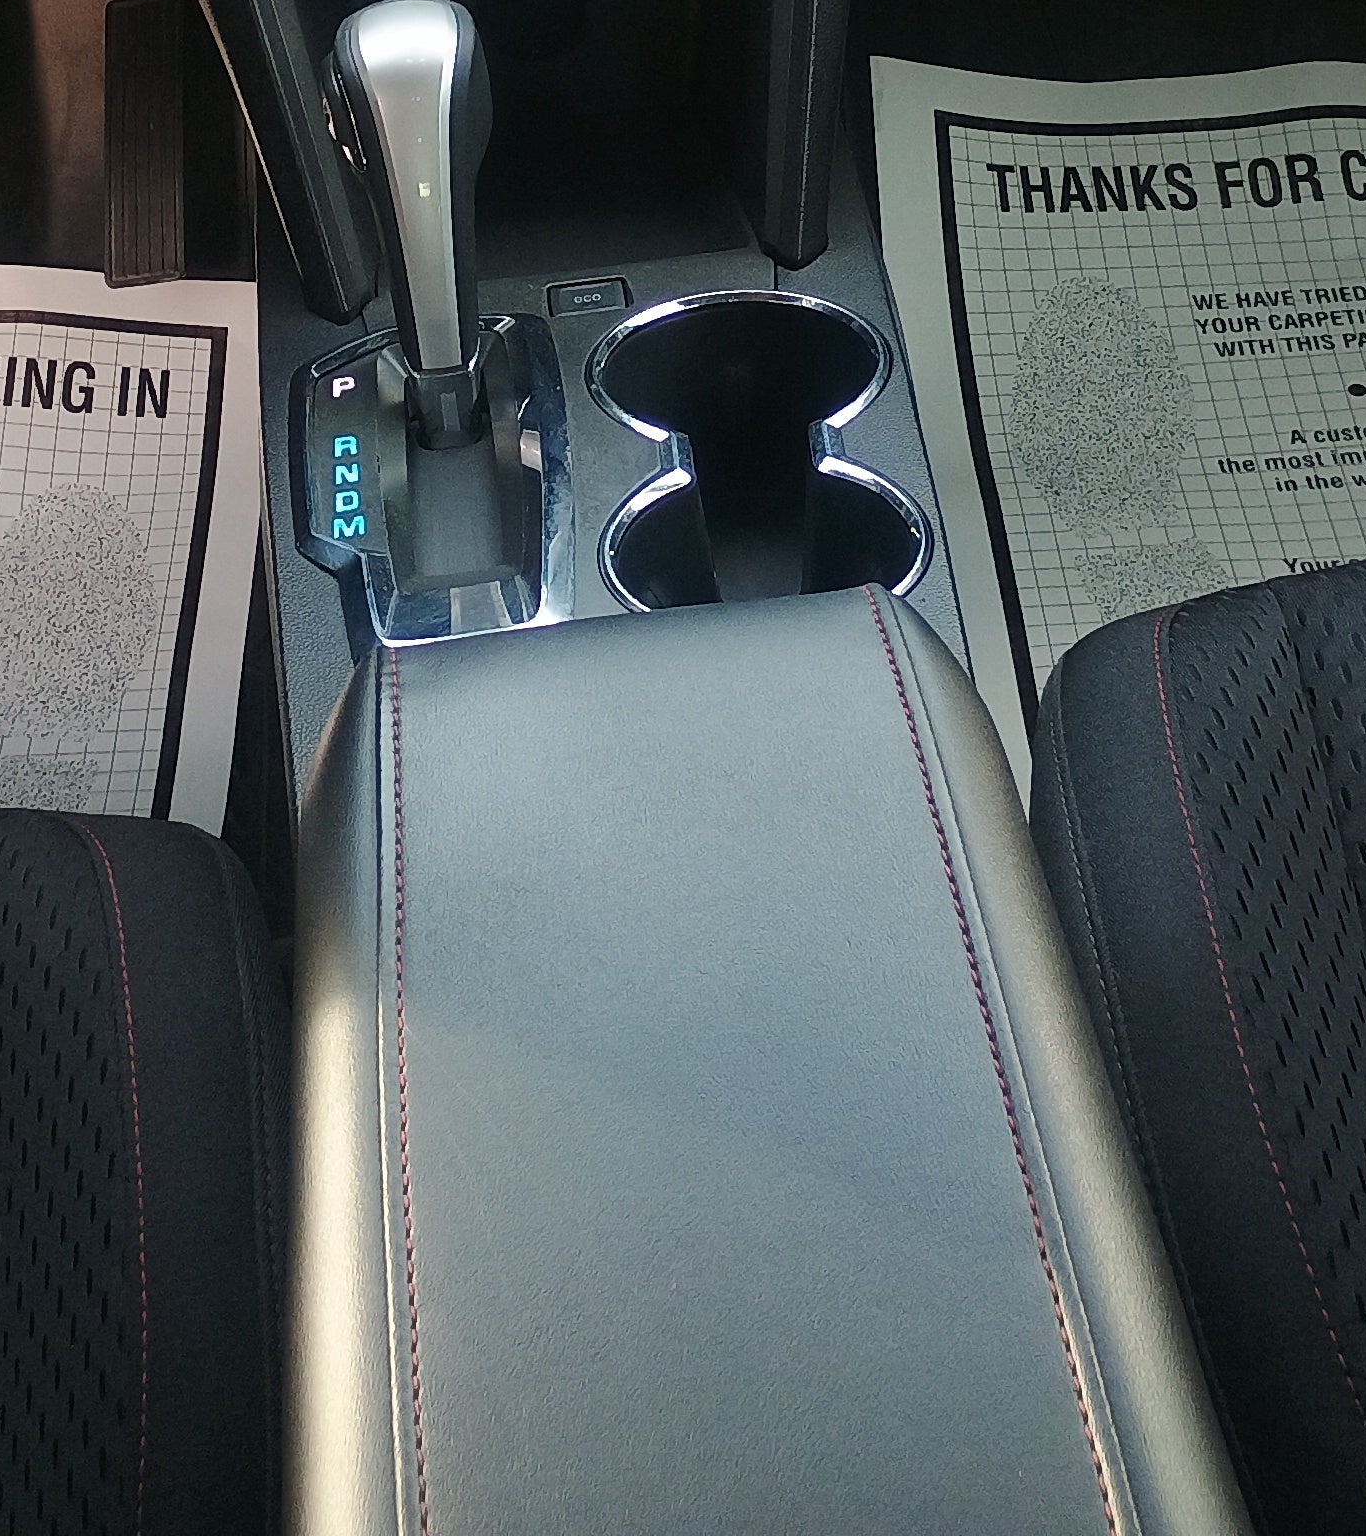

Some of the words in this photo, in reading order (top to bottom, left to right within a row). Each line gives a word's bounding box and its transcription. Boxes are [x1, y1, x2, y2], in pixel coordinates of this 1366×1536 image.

[986, 163, 1198, 213] THANKS
[1213, 153, 1325, 209] FOR
[1192, 293, 1230, 311] WE
[1236, 289, 1295, 309] HAVE
[1195, 315, 1260, 334] YOUR
[1214, 338, 1275, 358] WITH
[1280, 333, 1336, 353] THIS
[117, 366, 171, 418] IN
[332, 376, 355, 397] P
[333, 435, 358, 457] R
[1290, 429, 1308, 445] A
[1217, 457, 1256, 474] the
[1264, 451, 1325, 471] most
[334, 463, 359, 485] N
[1275, 476, 1299, 493] in
[1305, 474, 1344, 491] the
[335, 490, 359, 513] D
[333, 515, 366, 539] M
